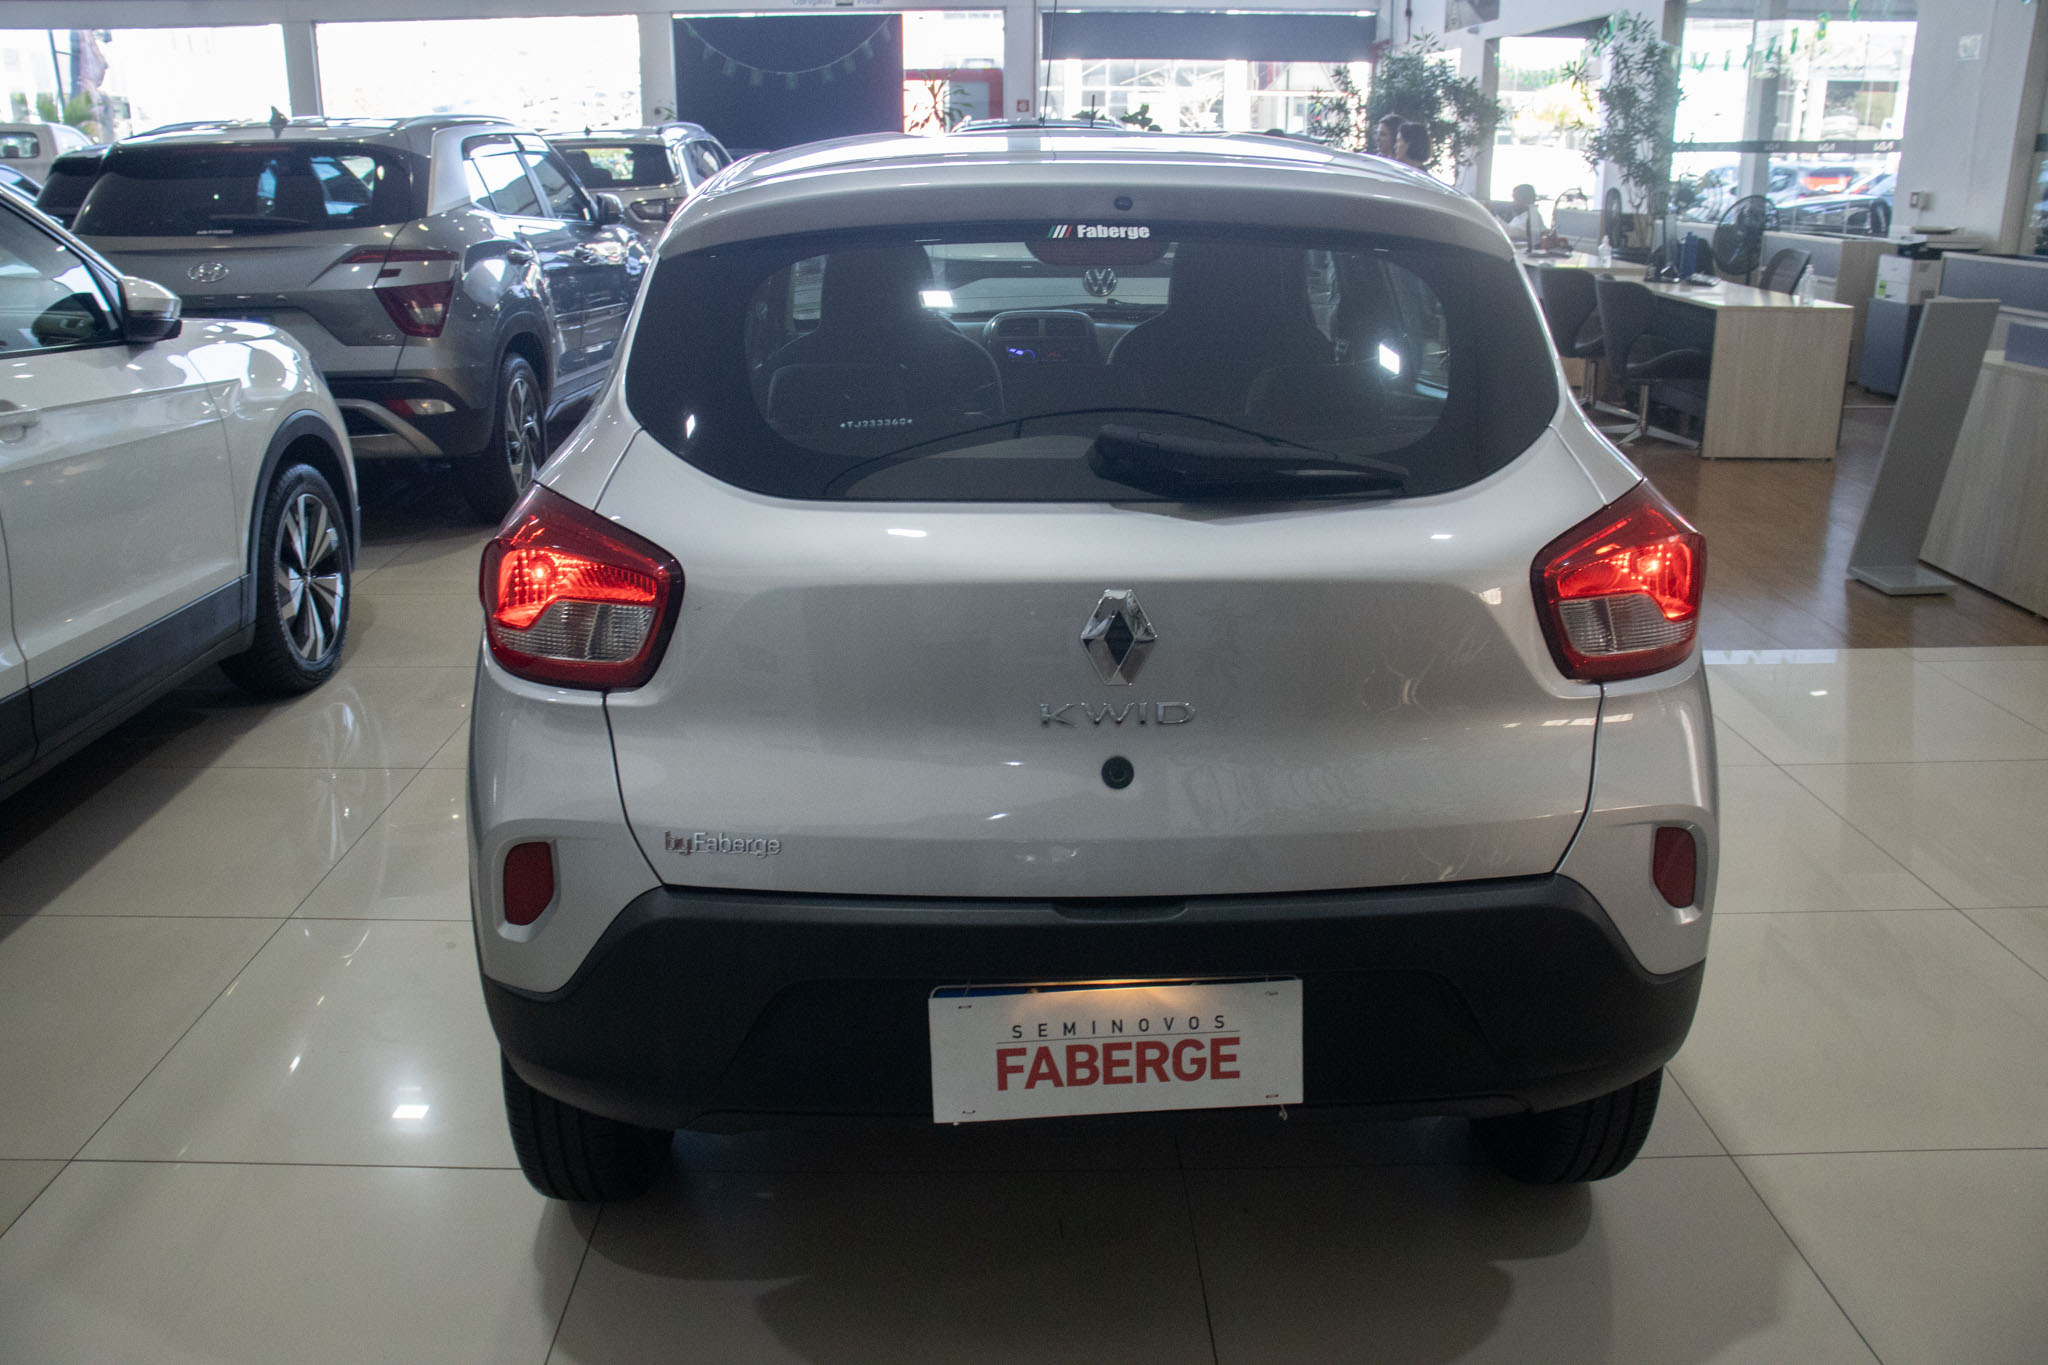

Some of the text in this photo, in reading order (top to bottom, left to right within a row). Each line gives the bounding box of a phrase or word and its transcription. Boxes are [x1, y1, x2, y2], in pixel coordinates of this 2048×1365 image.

[1077, 224, 1151, 239] Faberge
[1040, 702, 1196, 727] KWID
[1012, 1015, 1225, 1038] SEMINOVOS
[996, 1037, 1241, 1091] FABERGE
